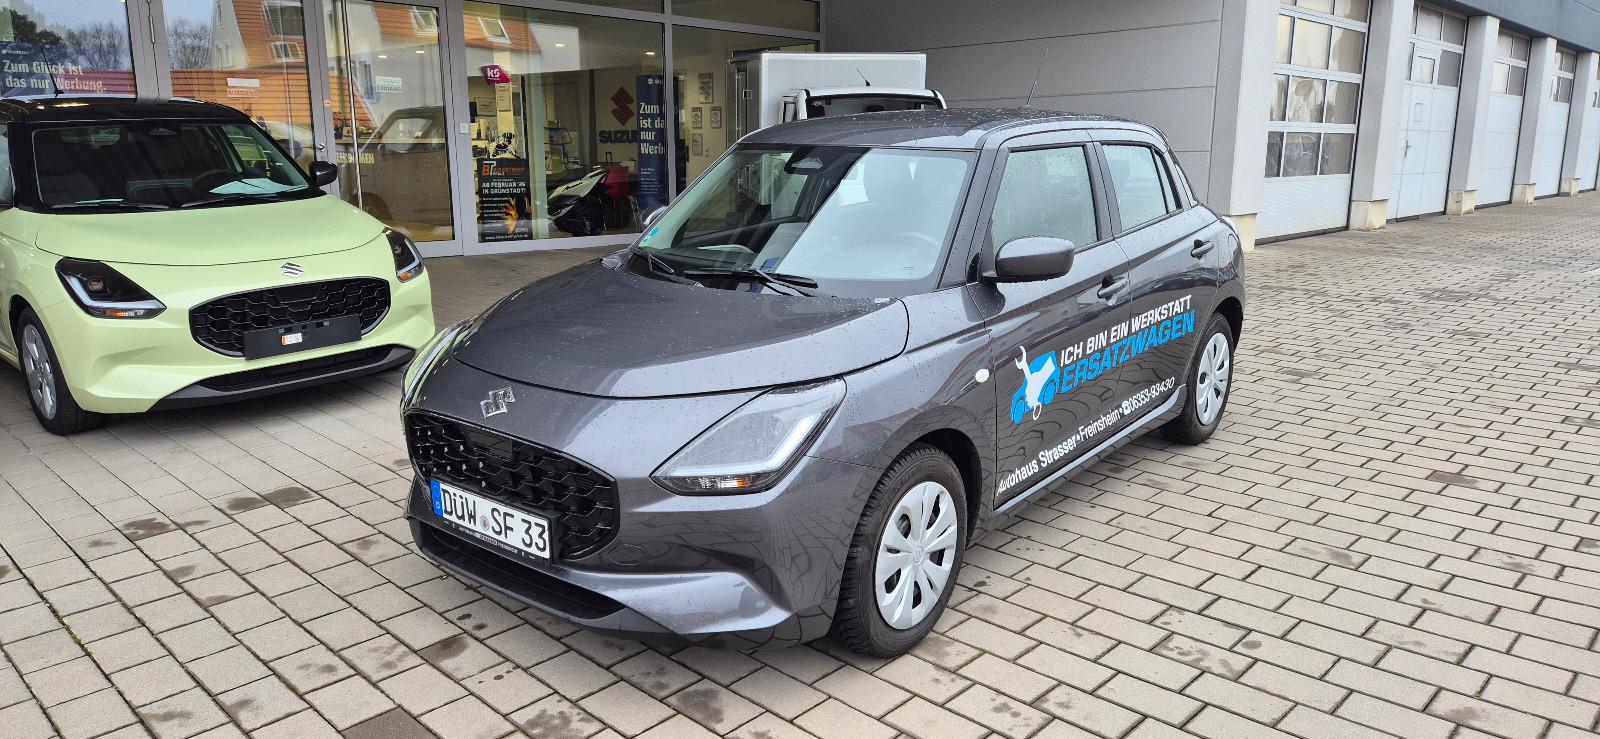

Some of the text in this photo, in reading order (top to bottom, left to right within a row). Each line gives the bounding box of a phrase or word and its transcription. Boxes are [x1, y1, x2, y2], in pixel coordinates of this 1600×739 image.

[3, 60, 84, 75] Zum Glück ist
[6, 75, 107, 94] das nur Werbung.
[640, 103, 659, 114] Zum
[640, 117, 665, 129] ist da
[641, 131, 656, 140] nur
[1060, 295, 1192, 367] ICH BIN EIN WERKSTATT
[1061, 309, 1196, 394] ERSATZWAGEN
[996, 376, 1176, 496] Autohaus Strasser Freinsheim 06353-93430
[441, 487, 477, 526] DÜW
[490, 507, 515, 540] SF
[520, 518, 548, 553] 33
